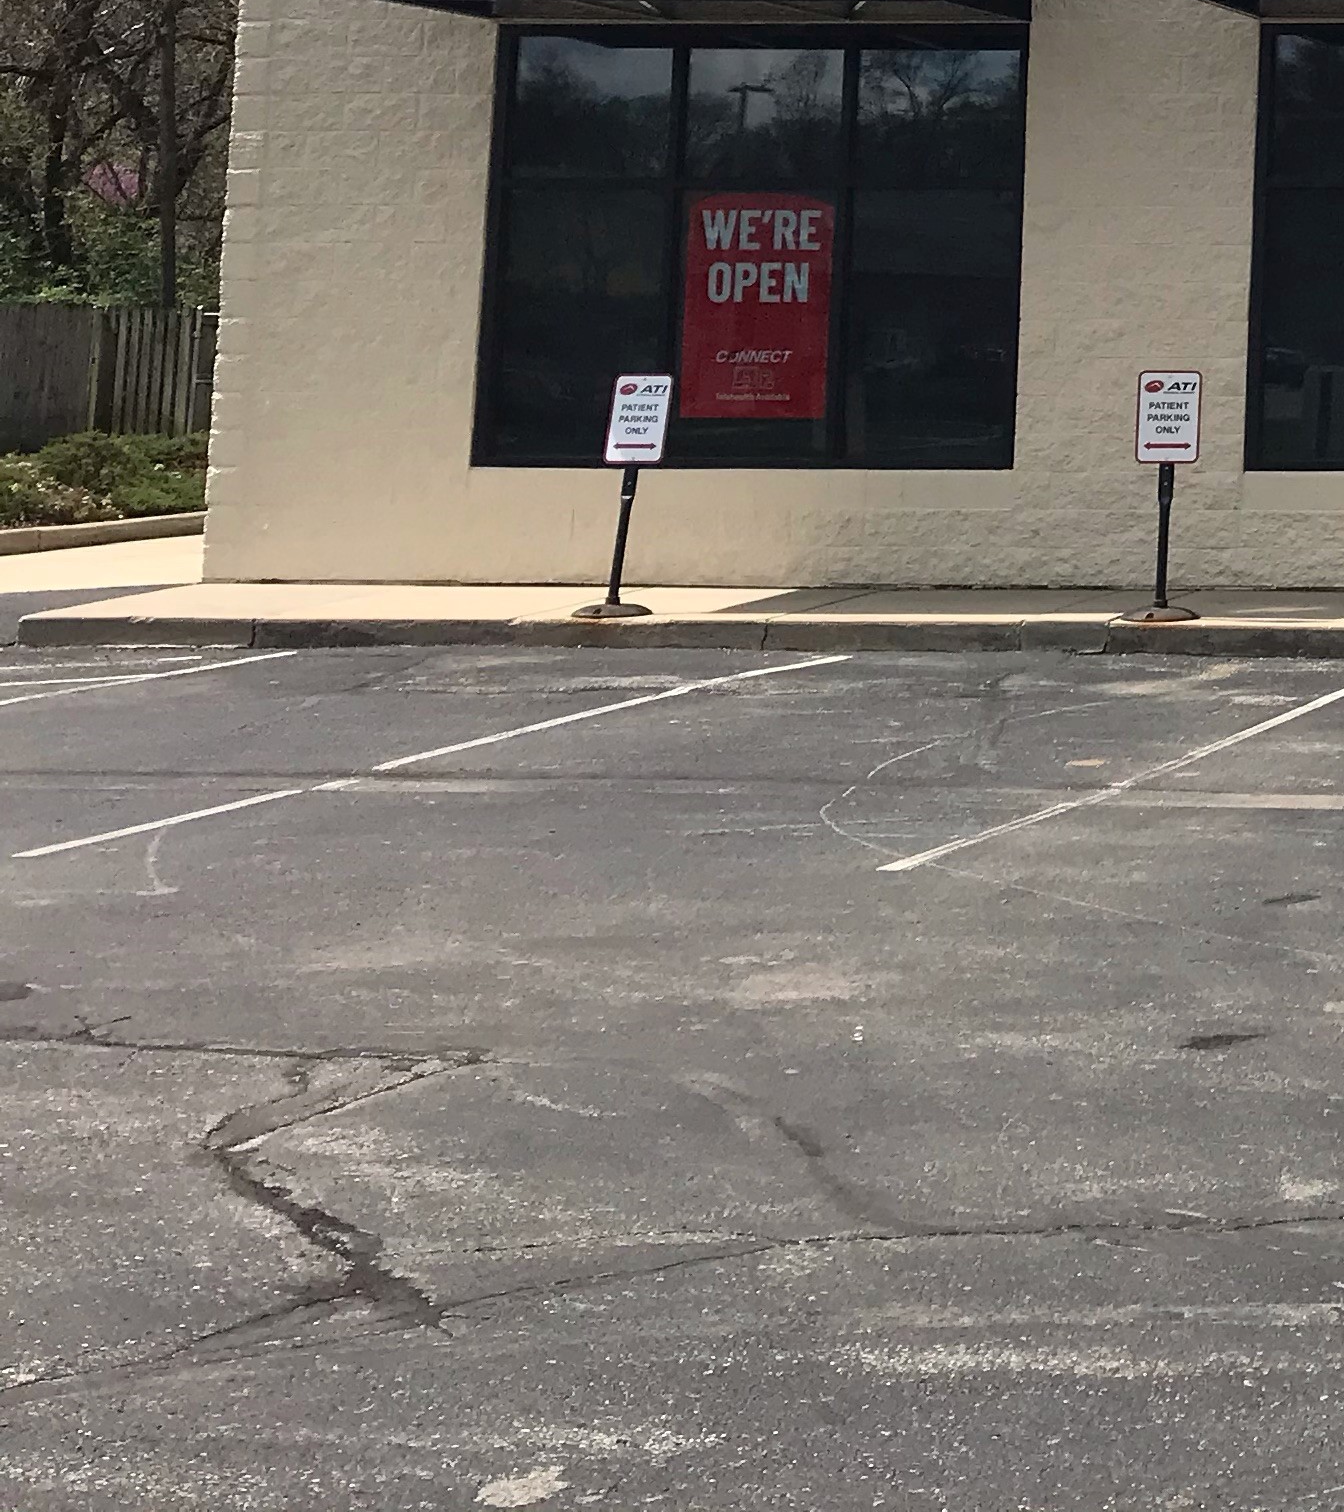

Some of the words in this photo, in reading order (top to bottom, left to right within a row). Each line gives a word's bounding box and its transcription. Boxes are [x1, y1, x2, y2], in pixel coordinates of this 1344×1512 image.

[702, 209, 823, 250] WE'RE
[707, 261, 810, 303] OPEN
[641, 385, 668, 394] ATI
[1167, 382, 1197, 391] ATI
[621, 403, 659, 411] PATIENT
[1148, 401, 1190, 409] PATIENT
[618, 415, 659, 423] PARKING
[1146, 413, 1191, 422] PARKING
[624, 427, 649, 435] ONLY
[1155, 426, 1181, 434] ONLY
